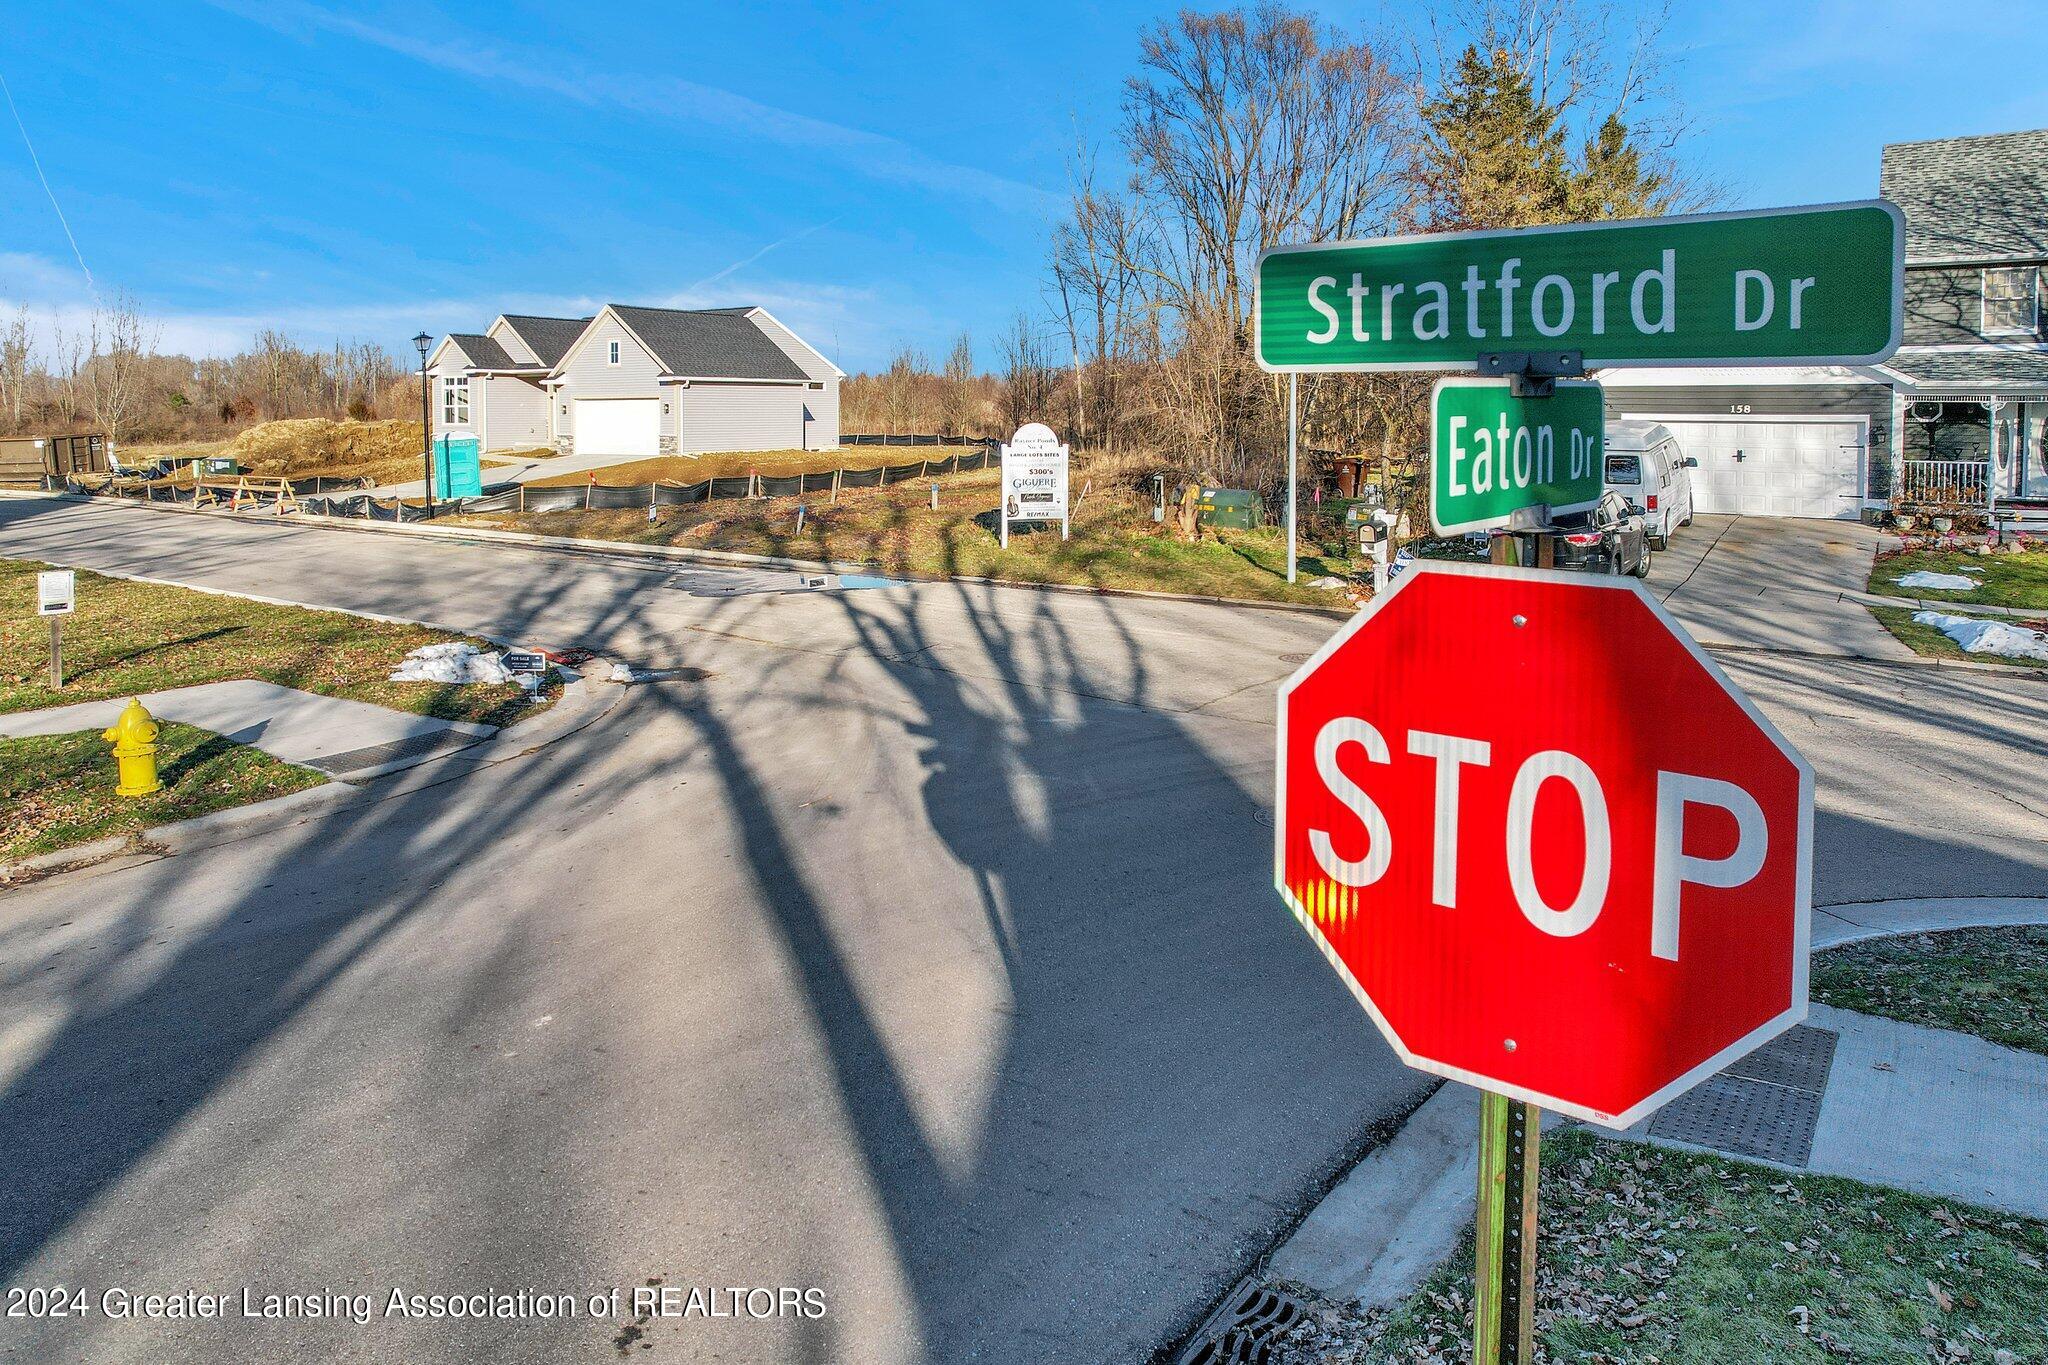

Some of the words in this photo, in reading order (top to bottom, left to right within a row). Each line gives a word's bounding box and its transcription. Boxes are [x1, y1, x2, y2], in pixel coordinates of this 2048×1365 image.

[1306, 249, 1676, 345] Stratford
[1734, 268, 1816, 331] Dr
[1730, 404, 1751, 414] 158
[1013, 478, 1056, 488] GIGUERE
[1448, 411, 1555, 498] Eaton
[1570, 427, 1596, 480] Dr
[1308, 716, 1769, 962] STOP
